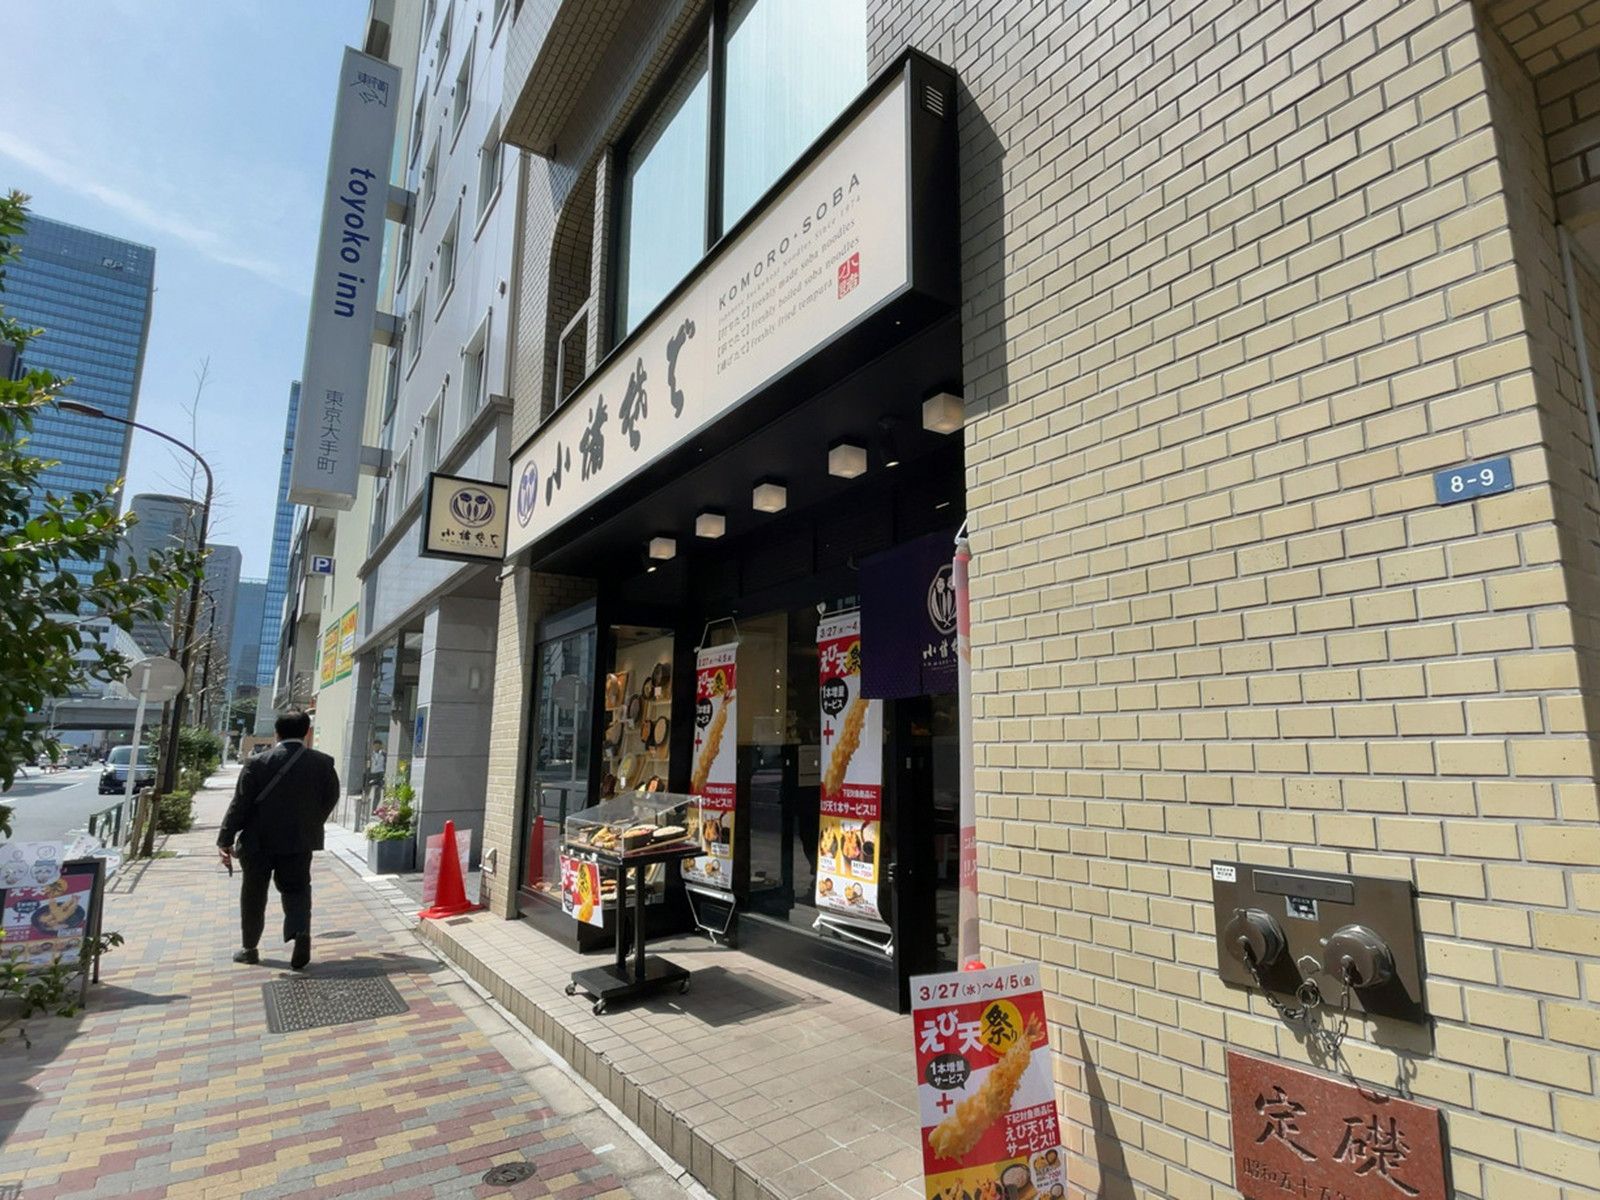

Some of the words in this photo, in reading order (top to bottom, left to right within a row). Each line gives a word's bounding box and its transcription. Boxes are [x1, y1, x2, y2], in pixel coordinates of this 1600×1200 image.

[340, 167, 376, 264] toyoko
[800, 251, 818, 271] soba
[821, 219, 855, 252] noodles
[804, 266, 822, 286] soba
[825, 237, 860, 270] noodles
[334, 272, 365, 318] inn
[317, 389, 344, 475] 東京大手町
[1451, 468, 1494, 493] 8-9
[315, 557, 329, 571] P
[930, 1061, 965, 1075] 1本増量
[934, 1073, 965, 1086] サービス
[1005, 1116, 1056, 1142] えび天1本
